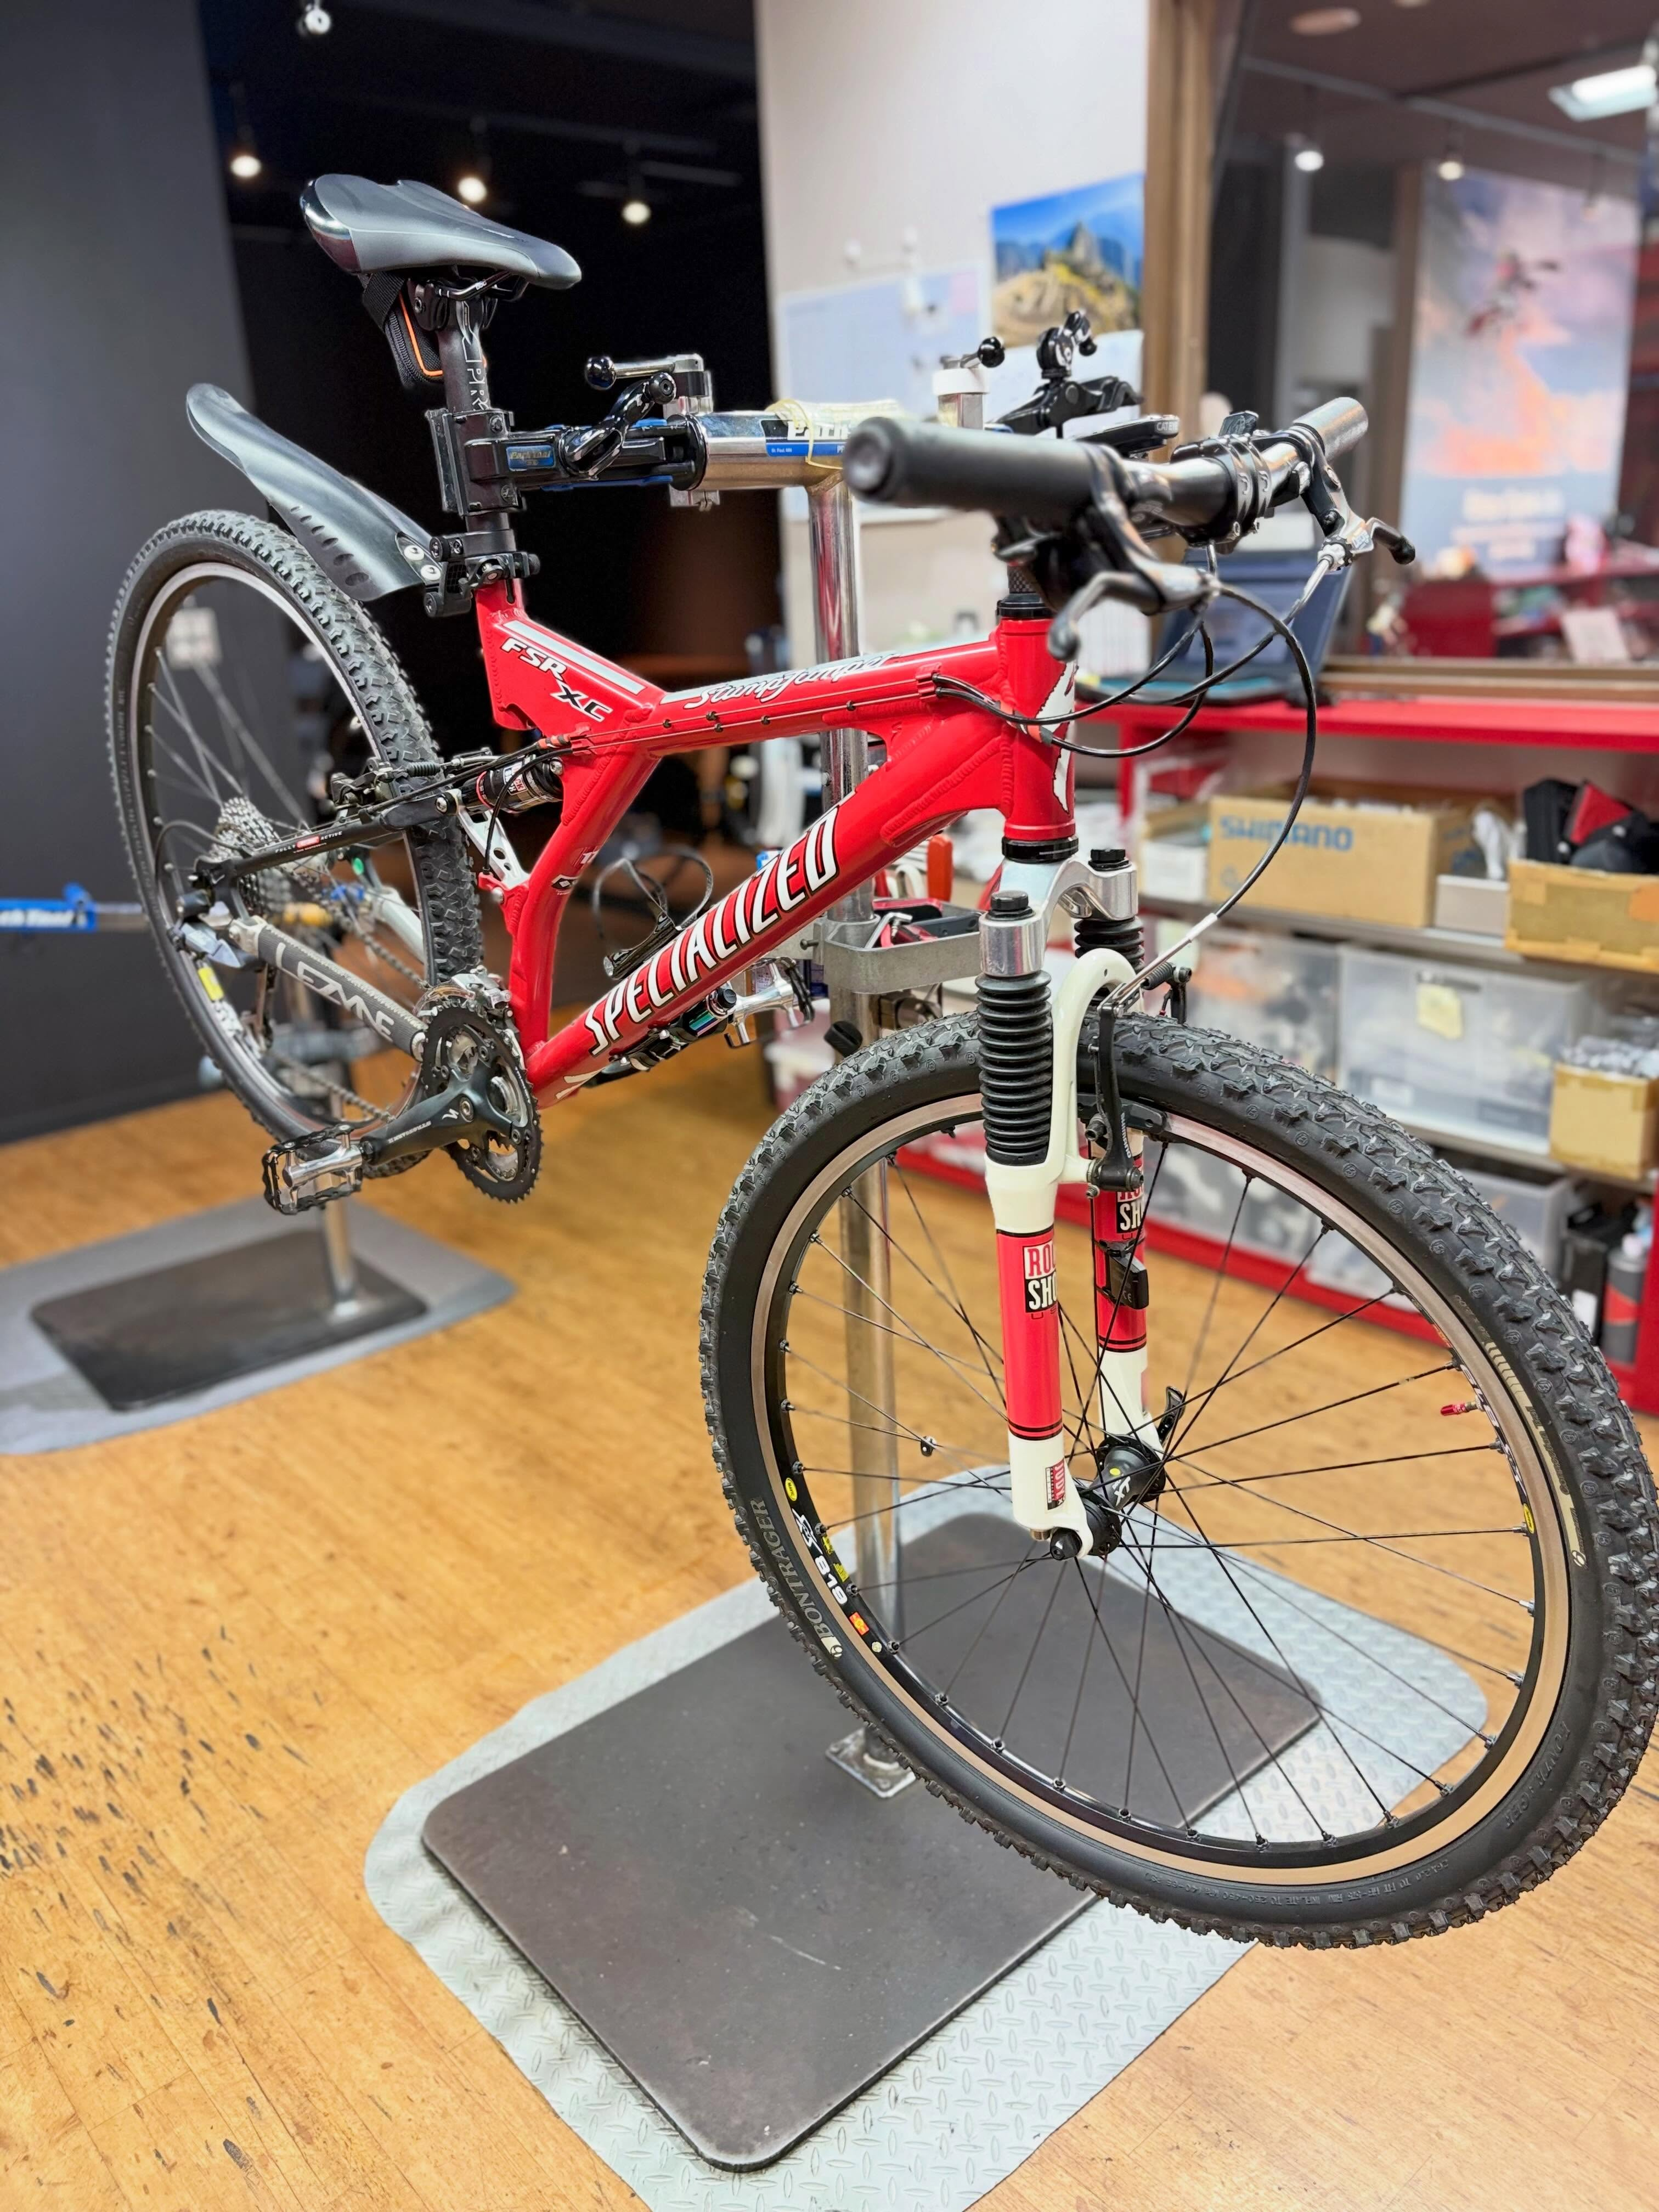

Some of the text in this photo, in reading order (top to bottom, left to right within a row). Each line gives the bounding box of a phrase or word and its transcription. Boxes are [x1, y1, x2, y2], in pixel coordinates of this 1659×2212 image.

[500, 637, 613, 723] FSR XC
[1220, 816, 1354, 852] SHIMANO
[584, 805, 840, 1056] SPECIALIZED
[1119, 1200, 1145, 1231] SH
[1027, 1243, 1056, 1277] RO
[1028, 1270, 1057, 1310] SHO
[750, 1498, 836, 1638] BONTRAGER
[815, 1555, 848, 1605] 819
